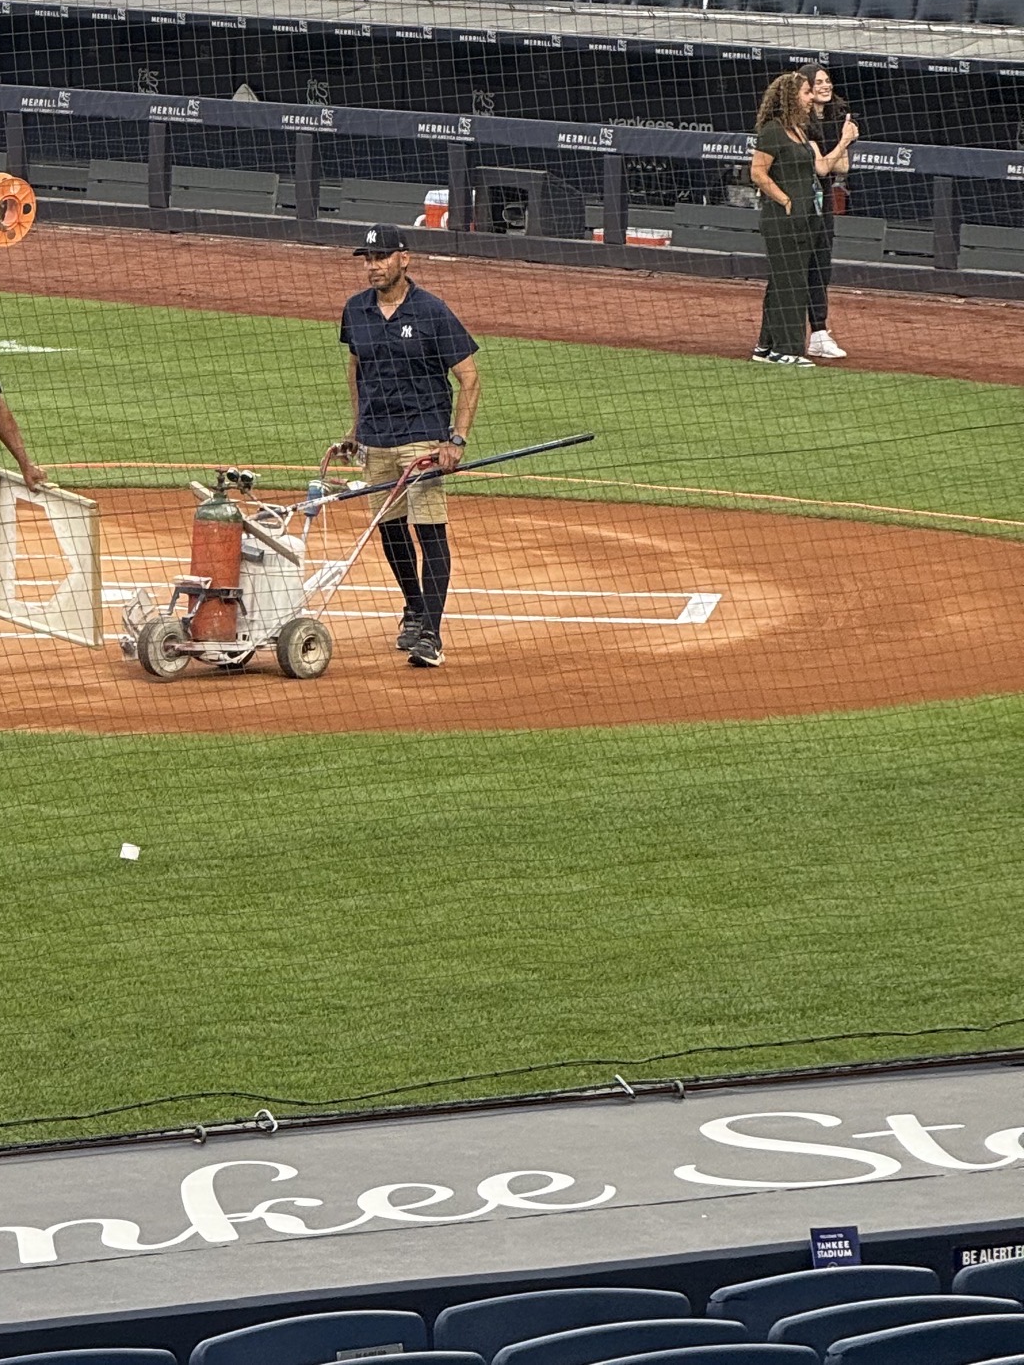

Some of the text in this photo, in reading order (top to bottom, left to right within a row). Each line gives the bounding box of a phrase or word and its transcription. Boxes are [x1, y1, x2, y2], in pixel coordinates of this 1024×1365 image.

[524, 39, 550, 47] MERRILL
[589, 43, 616, 51] MERRILL
[928, 65, 958, 73] MERRILL
[22, 98, 56, 107] MERRILL
[150, 106, 186, 116] MERRILL
[282, 115, 318, 125] MERRILL
[418, 123, 456, 134] MERRILL
[558, 134, 597, 145] MERRILL
[702, 143, 744, 154] MERRILL
[853, 153, 894, 165] MERRILL
[366, 229, 378, 245] NY
[400, 323, 414, 339] NY
[674, 1112, 1024, 1188] St
[817, 1240, 850, 1250] YANKEE
[817, 1249, 853, 1259] STADIUM
[962, 1250, 978, 1266] BE
[979, 1246, 1014, 1264] ALERT
